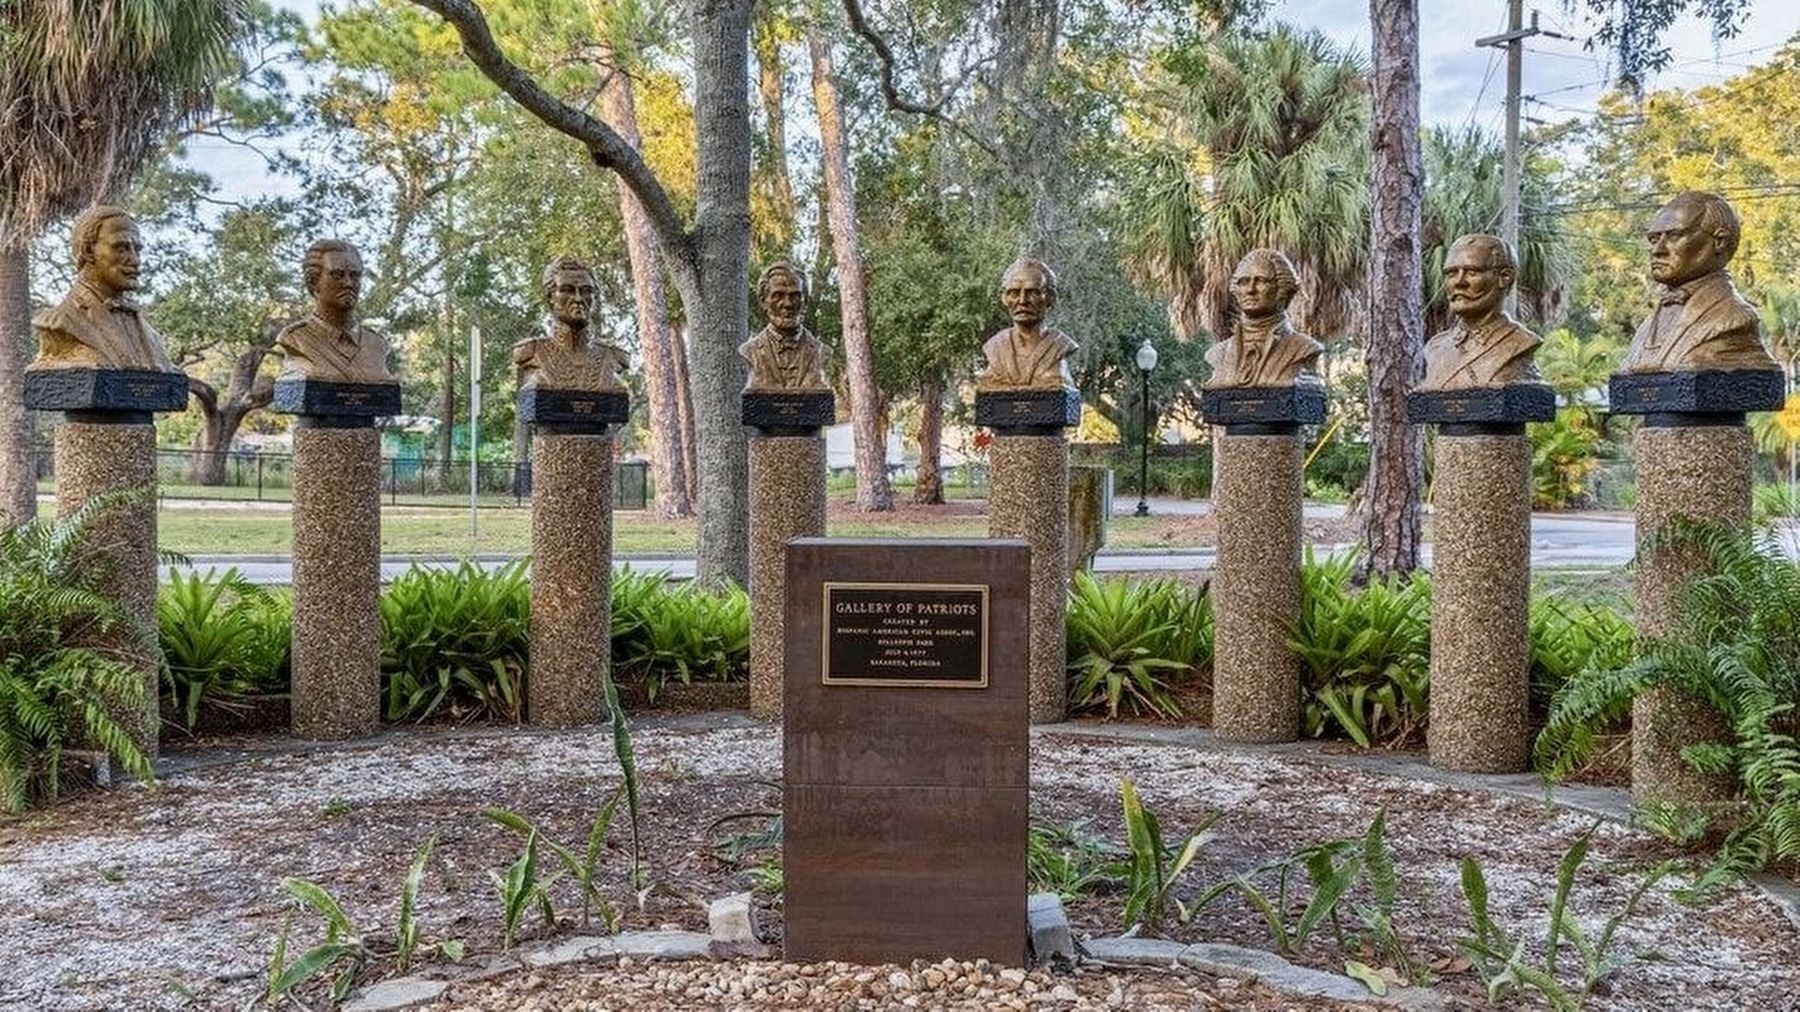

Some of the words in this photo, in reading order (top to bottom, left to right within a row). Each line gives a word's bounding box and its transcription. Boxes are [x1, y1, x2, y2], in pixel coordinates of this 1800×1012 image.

[836, 603, 892, 613] GALLERY
[896, 603, 913, 613] OF
[918, 604, 977, 615] PATRIOTS
